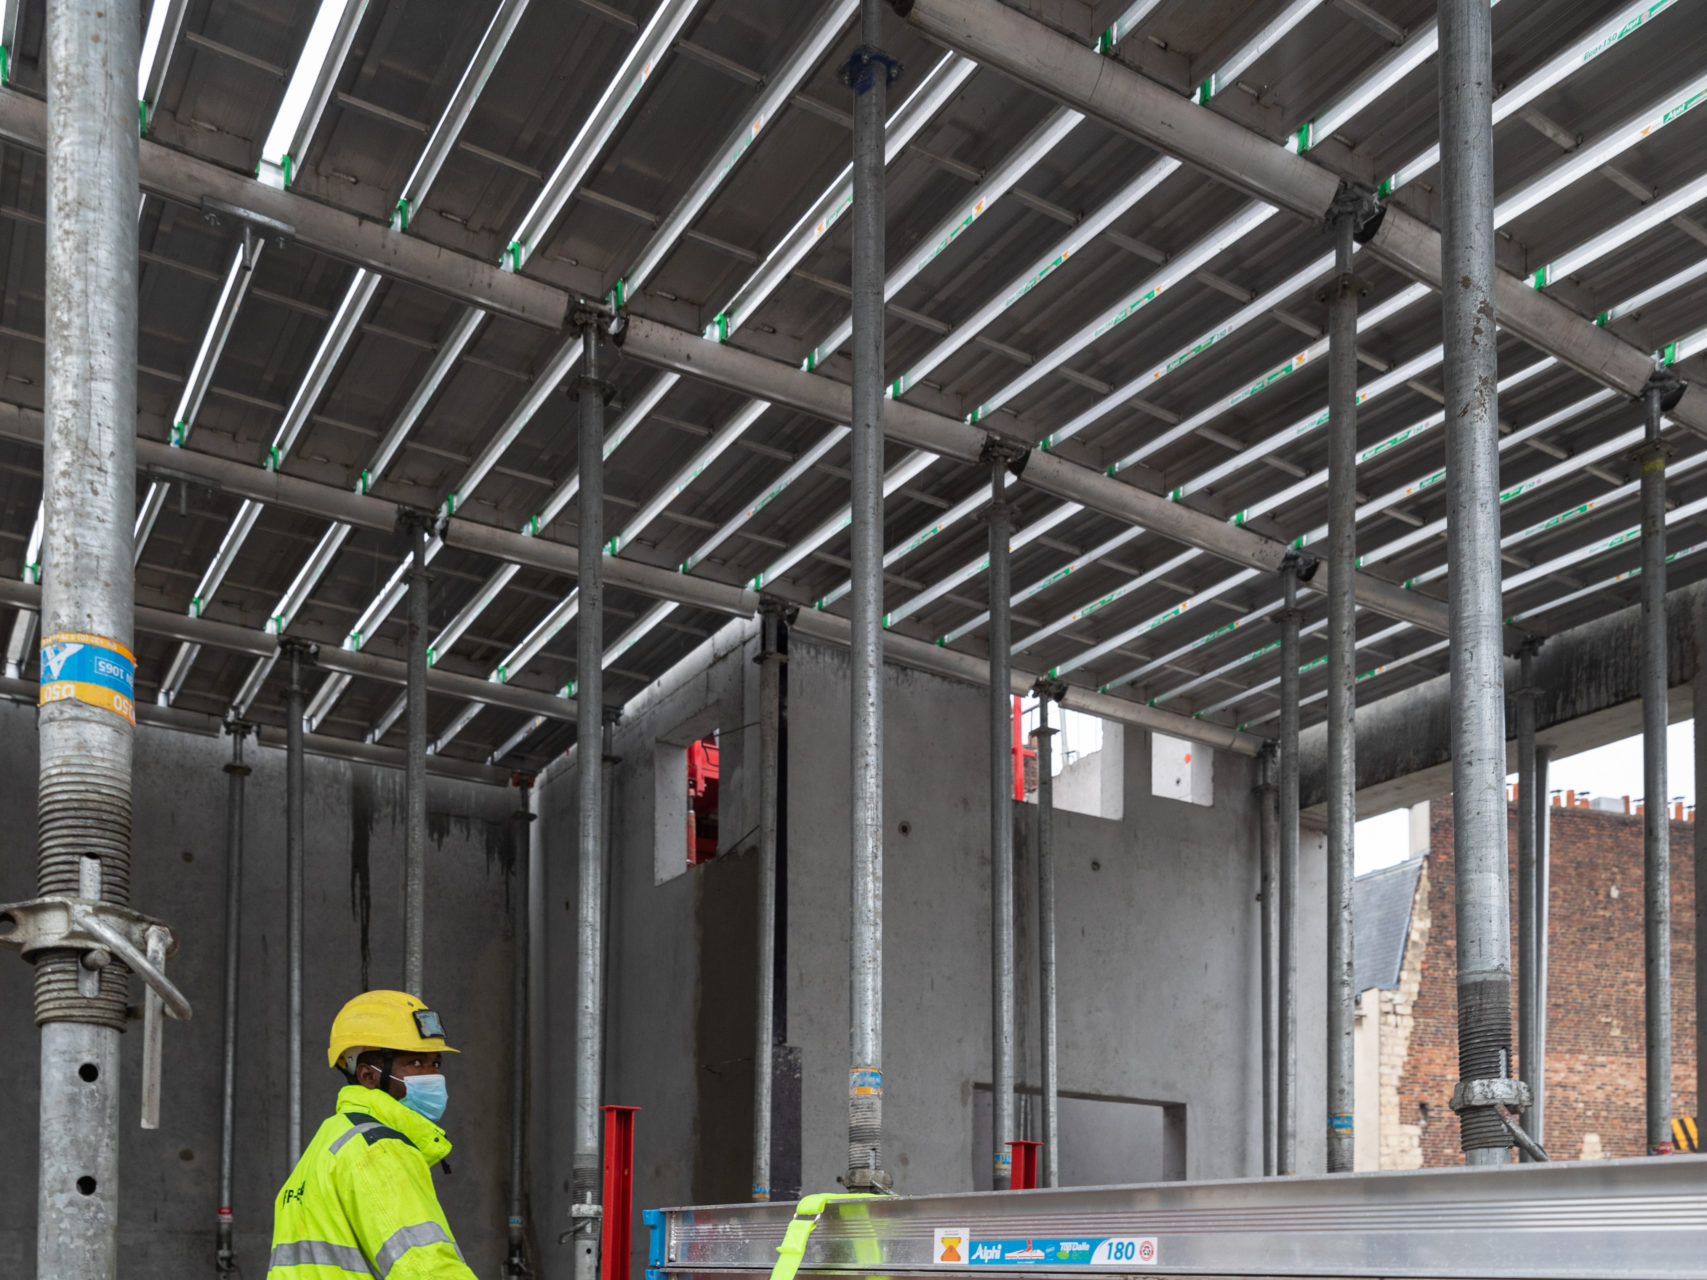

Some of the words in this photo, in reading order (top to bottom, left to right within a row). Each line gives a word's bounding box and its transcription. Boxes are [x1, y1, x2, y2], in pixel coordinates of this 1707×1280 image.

[98, 660, 124, 680] 1065
[44, 683, 75, 701] D50
[971, 1243, 1002, 1263] Alphi
[1107, 1241, 1136, 1261] 180
